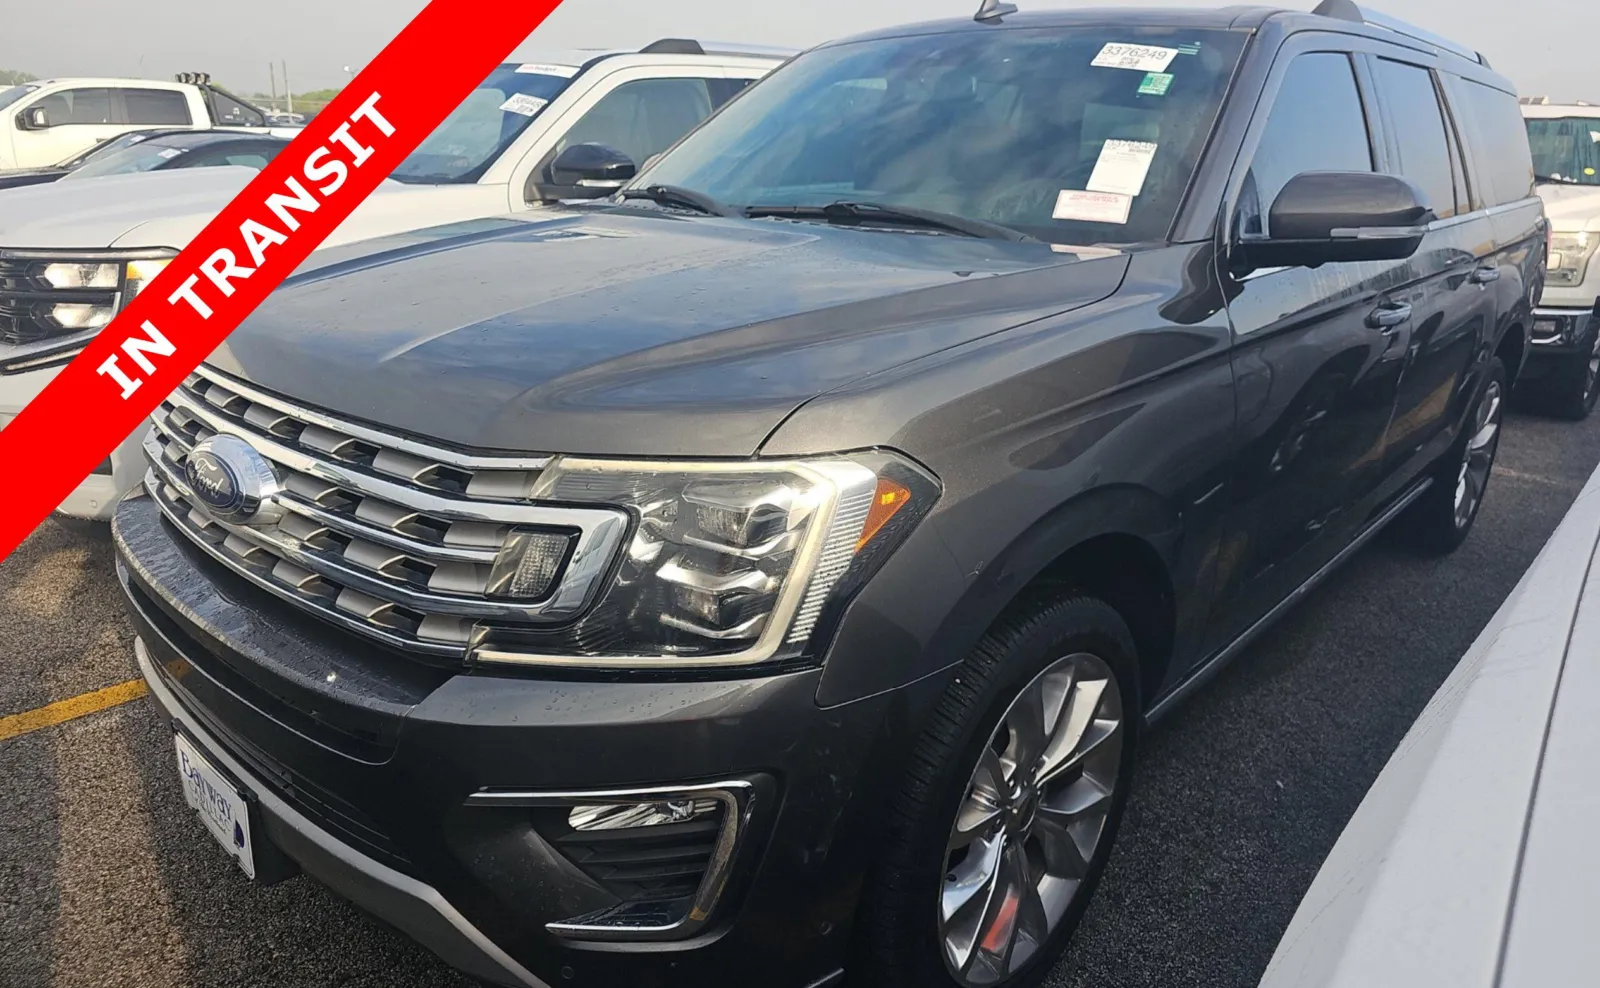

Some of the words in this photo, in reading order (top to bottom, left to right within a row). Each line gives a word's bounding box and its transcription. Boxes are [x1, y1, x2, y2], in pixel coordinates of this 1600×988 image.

[1102, 45, 1168, 60] 3376249
[194, 457, 223, 491] Ford
[179, 750, 232, 822] Bayway
[188, 779, 231, 832] CADILLAC
